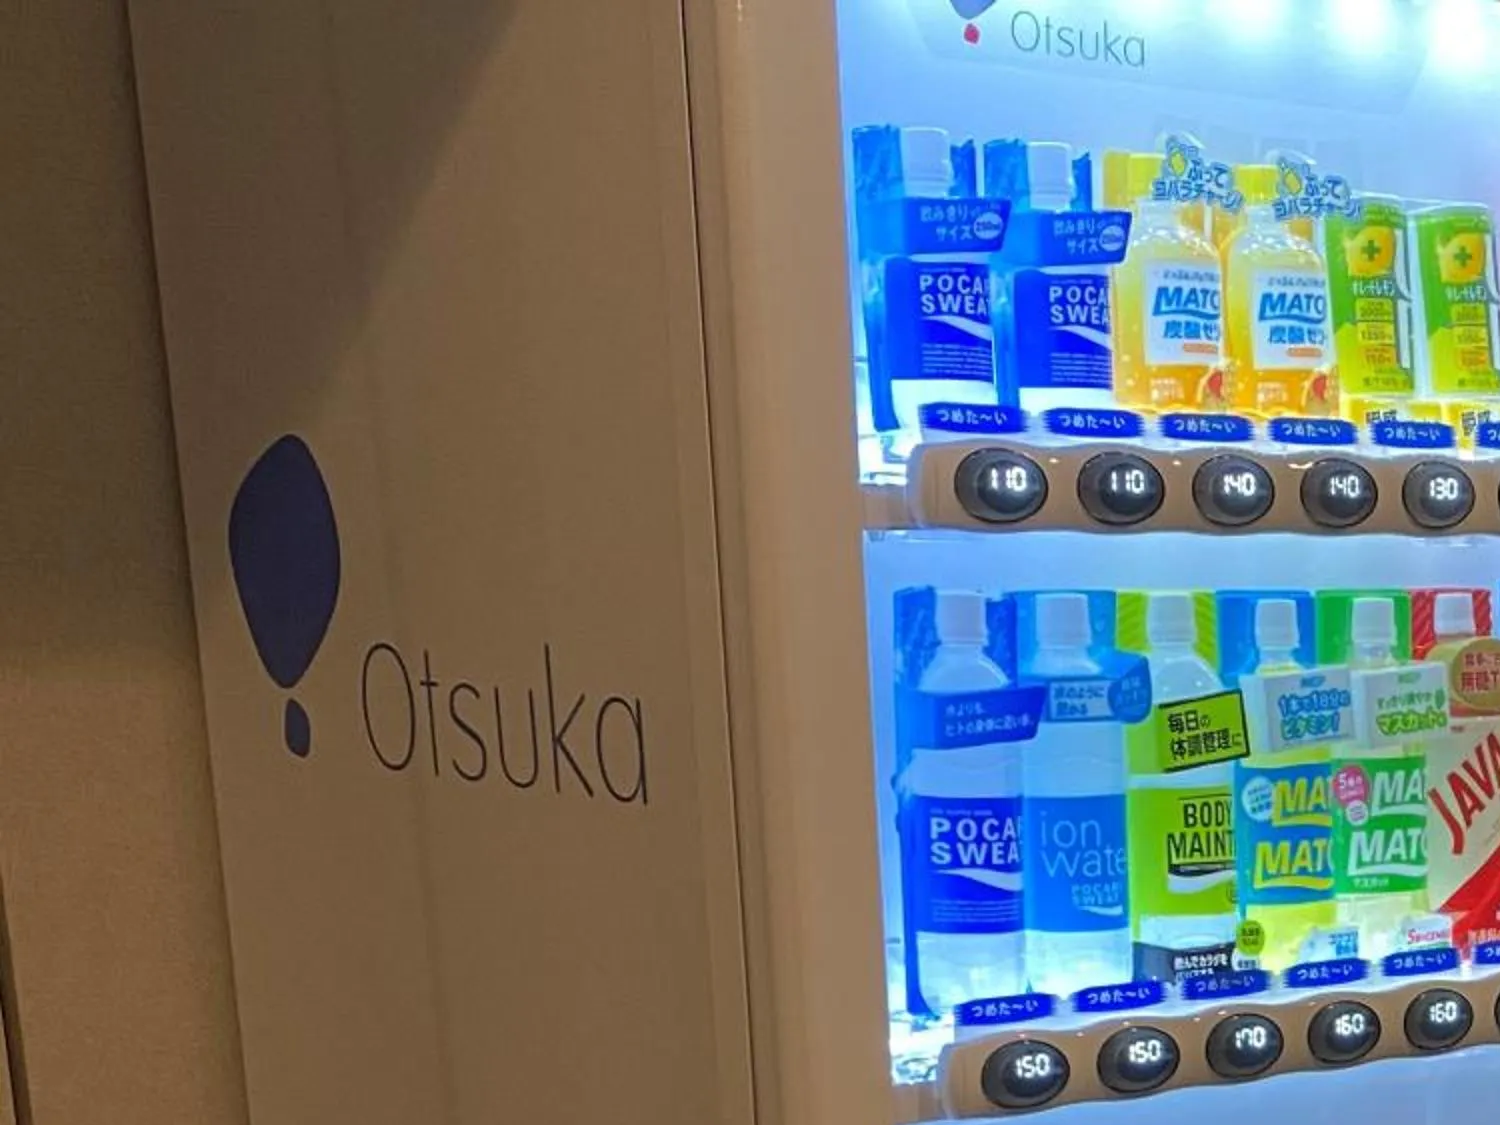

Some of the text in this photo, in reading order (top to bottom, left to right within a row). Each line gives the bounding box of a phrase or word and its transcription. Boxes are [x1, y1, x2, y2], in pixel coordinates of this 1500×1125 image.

[1011, 10, 1146, 68] Otsuka
[990, 466, 1027, 491] 110
[1110, 469, 1145, 494] 110
[1223, 473, 1256, 496] 140
[1329, 475, 1360, 498] 140
[1429, 477, 1459, 500] 130
[361, 642, 648, 805] Otsuka
[1168, 710, 1210, 735] 毎日の
[1171, 728, 1243, 761] 体調管理に
[1041, 810, 1101, 849] ion
[1350, 826, 1428, 864] MAT
[1255, 840, 1333, 875] MAT
[1015, 1053, 1050, 1078] 150
[1129, 1041, 1161, 1064] 150
[1334, 1013, 1364, 1035] 160
[1429, 1001, 1457, 1023] 160
